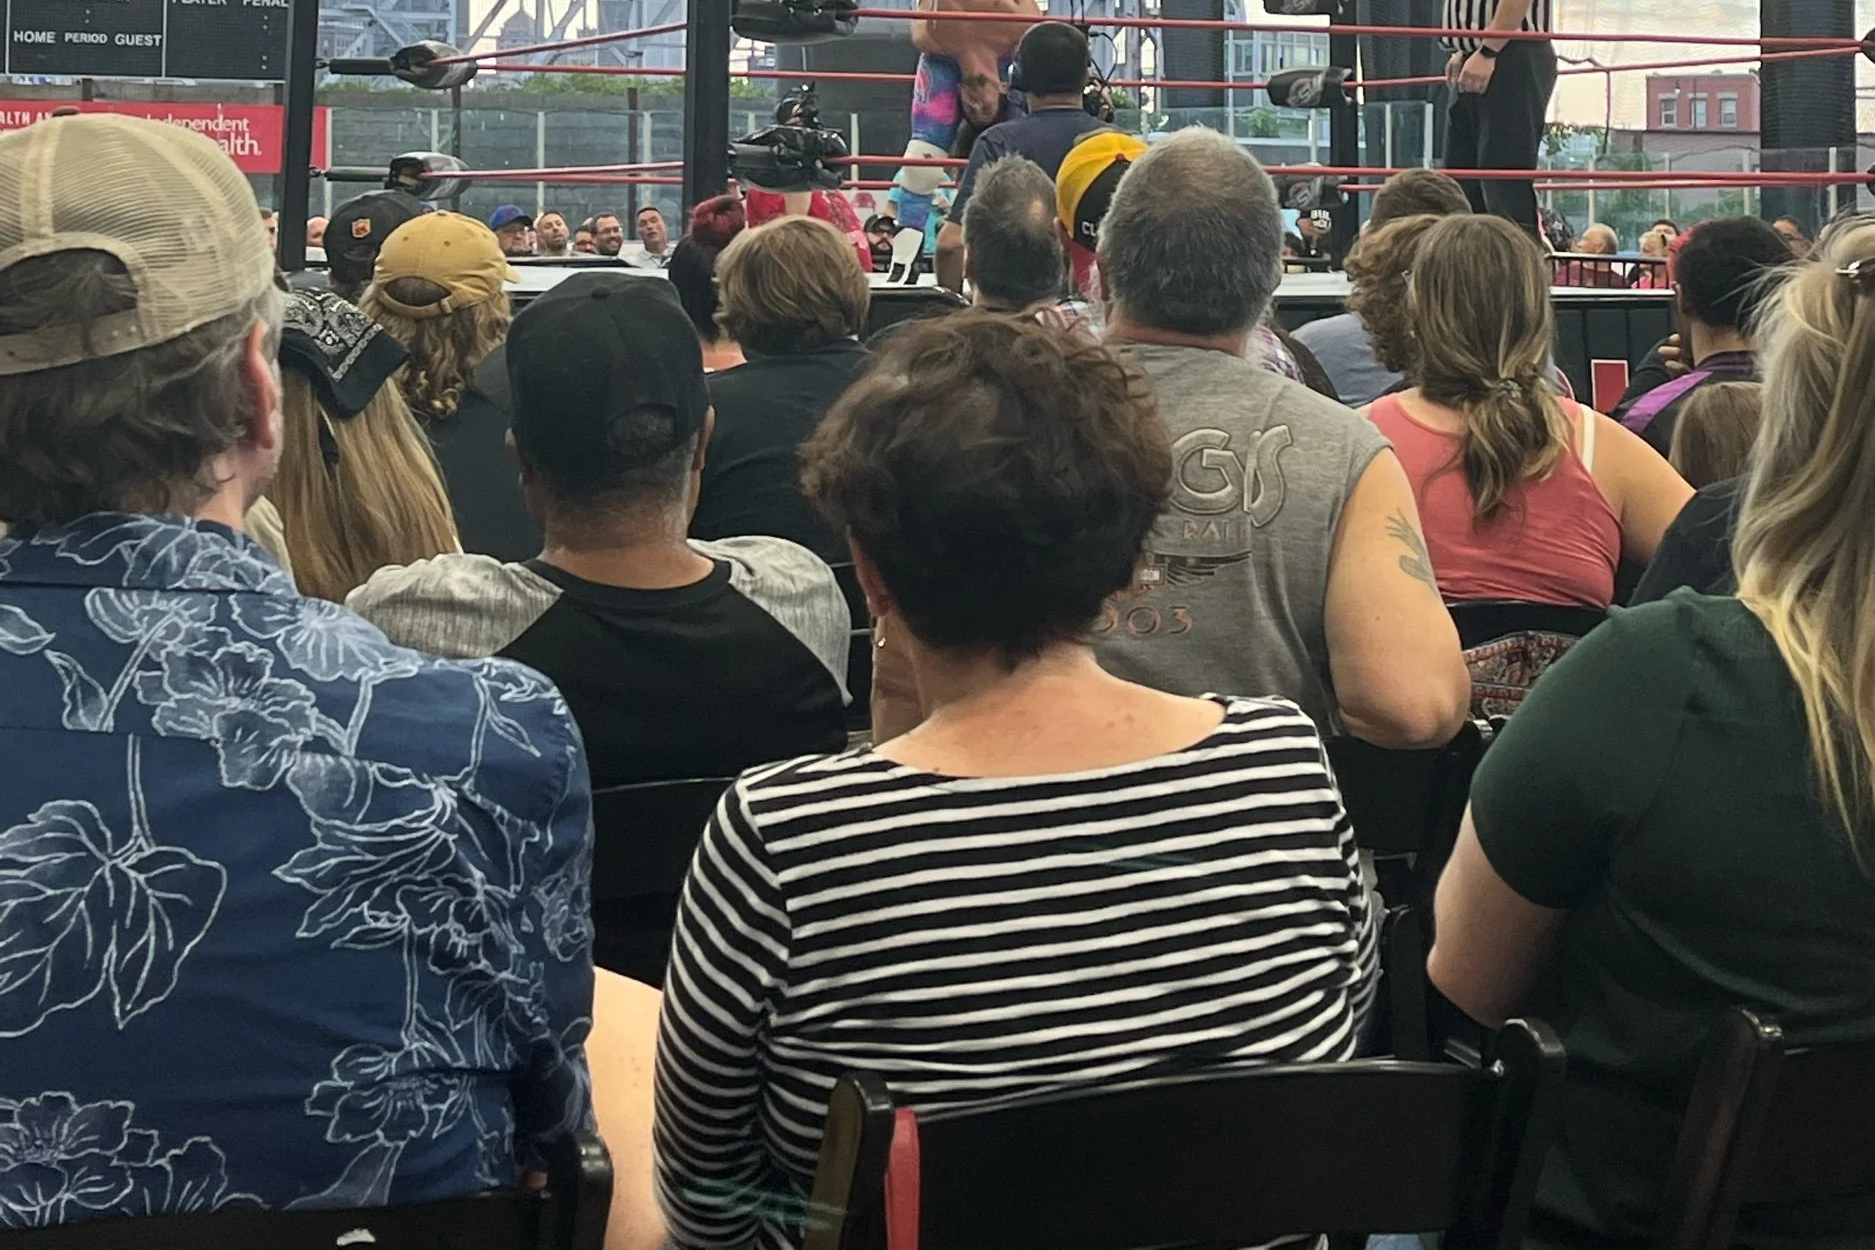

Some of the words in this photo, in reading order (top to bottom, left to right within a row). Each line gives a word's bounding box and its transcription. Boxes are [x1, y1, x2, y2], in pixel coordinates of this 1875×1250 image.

[13, 30, 56, 43] HOME
[64, 32, 108, 44] PERIOD
[114, 33, 162, 46] GUEST
[147, 113, 250, 132] dependent
[219, 132, 262, 156] alth.
[1081, 221, 1098, 237] CL
